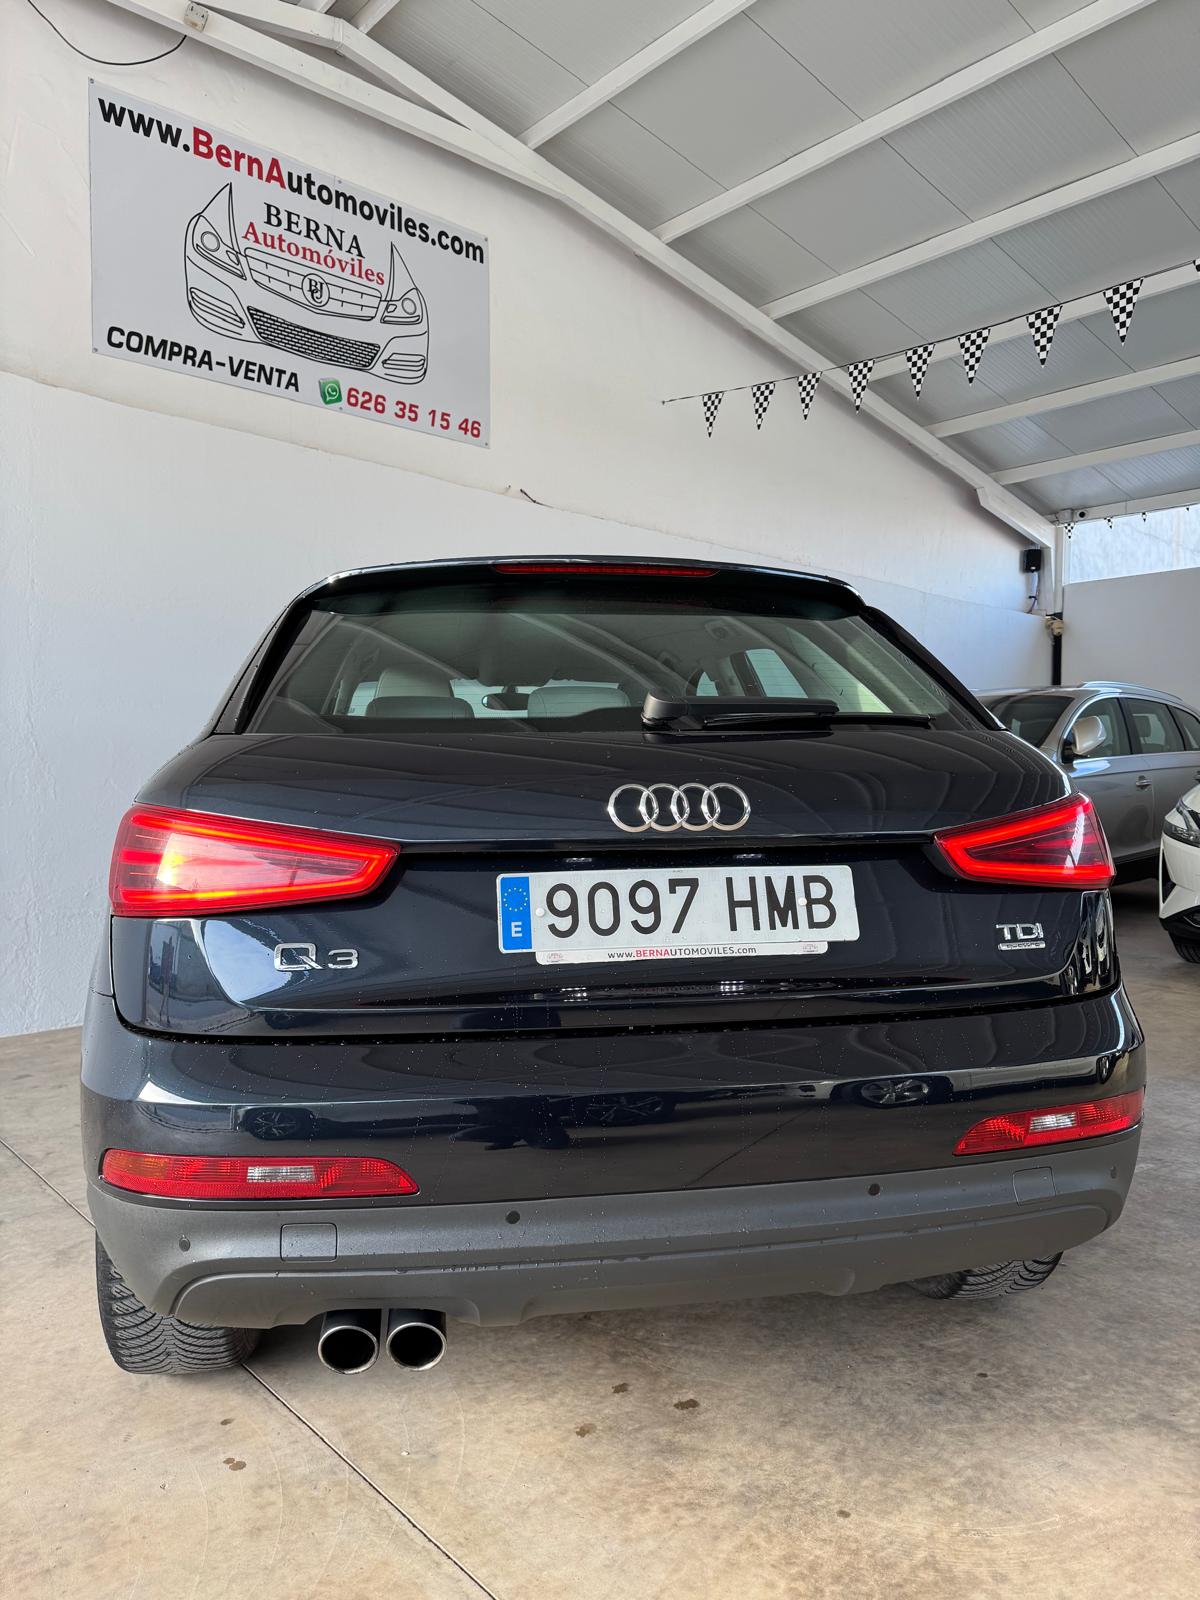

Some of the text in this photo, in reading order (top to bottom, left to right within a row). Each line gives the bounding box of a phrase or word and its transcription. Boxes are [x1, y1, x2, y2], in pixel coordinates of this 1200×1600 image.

[97, 97, 484, 264] www.BernAutomoviles.com
[241, 221, 385, 286] Automóviles
[263, 201, 366, 259] BERNA
[106, 326, 300, 393] COMPRA-VENTA
[346, 387, 482, 439] 626 35 15 46
[511, 921, 523, 938] E
[545, 874, 838, 939] 9097 HMB
[995, 922, 1044, 941] TDI
[607, 945, 758, 960] www.BERNAUTOMOVILES.com
